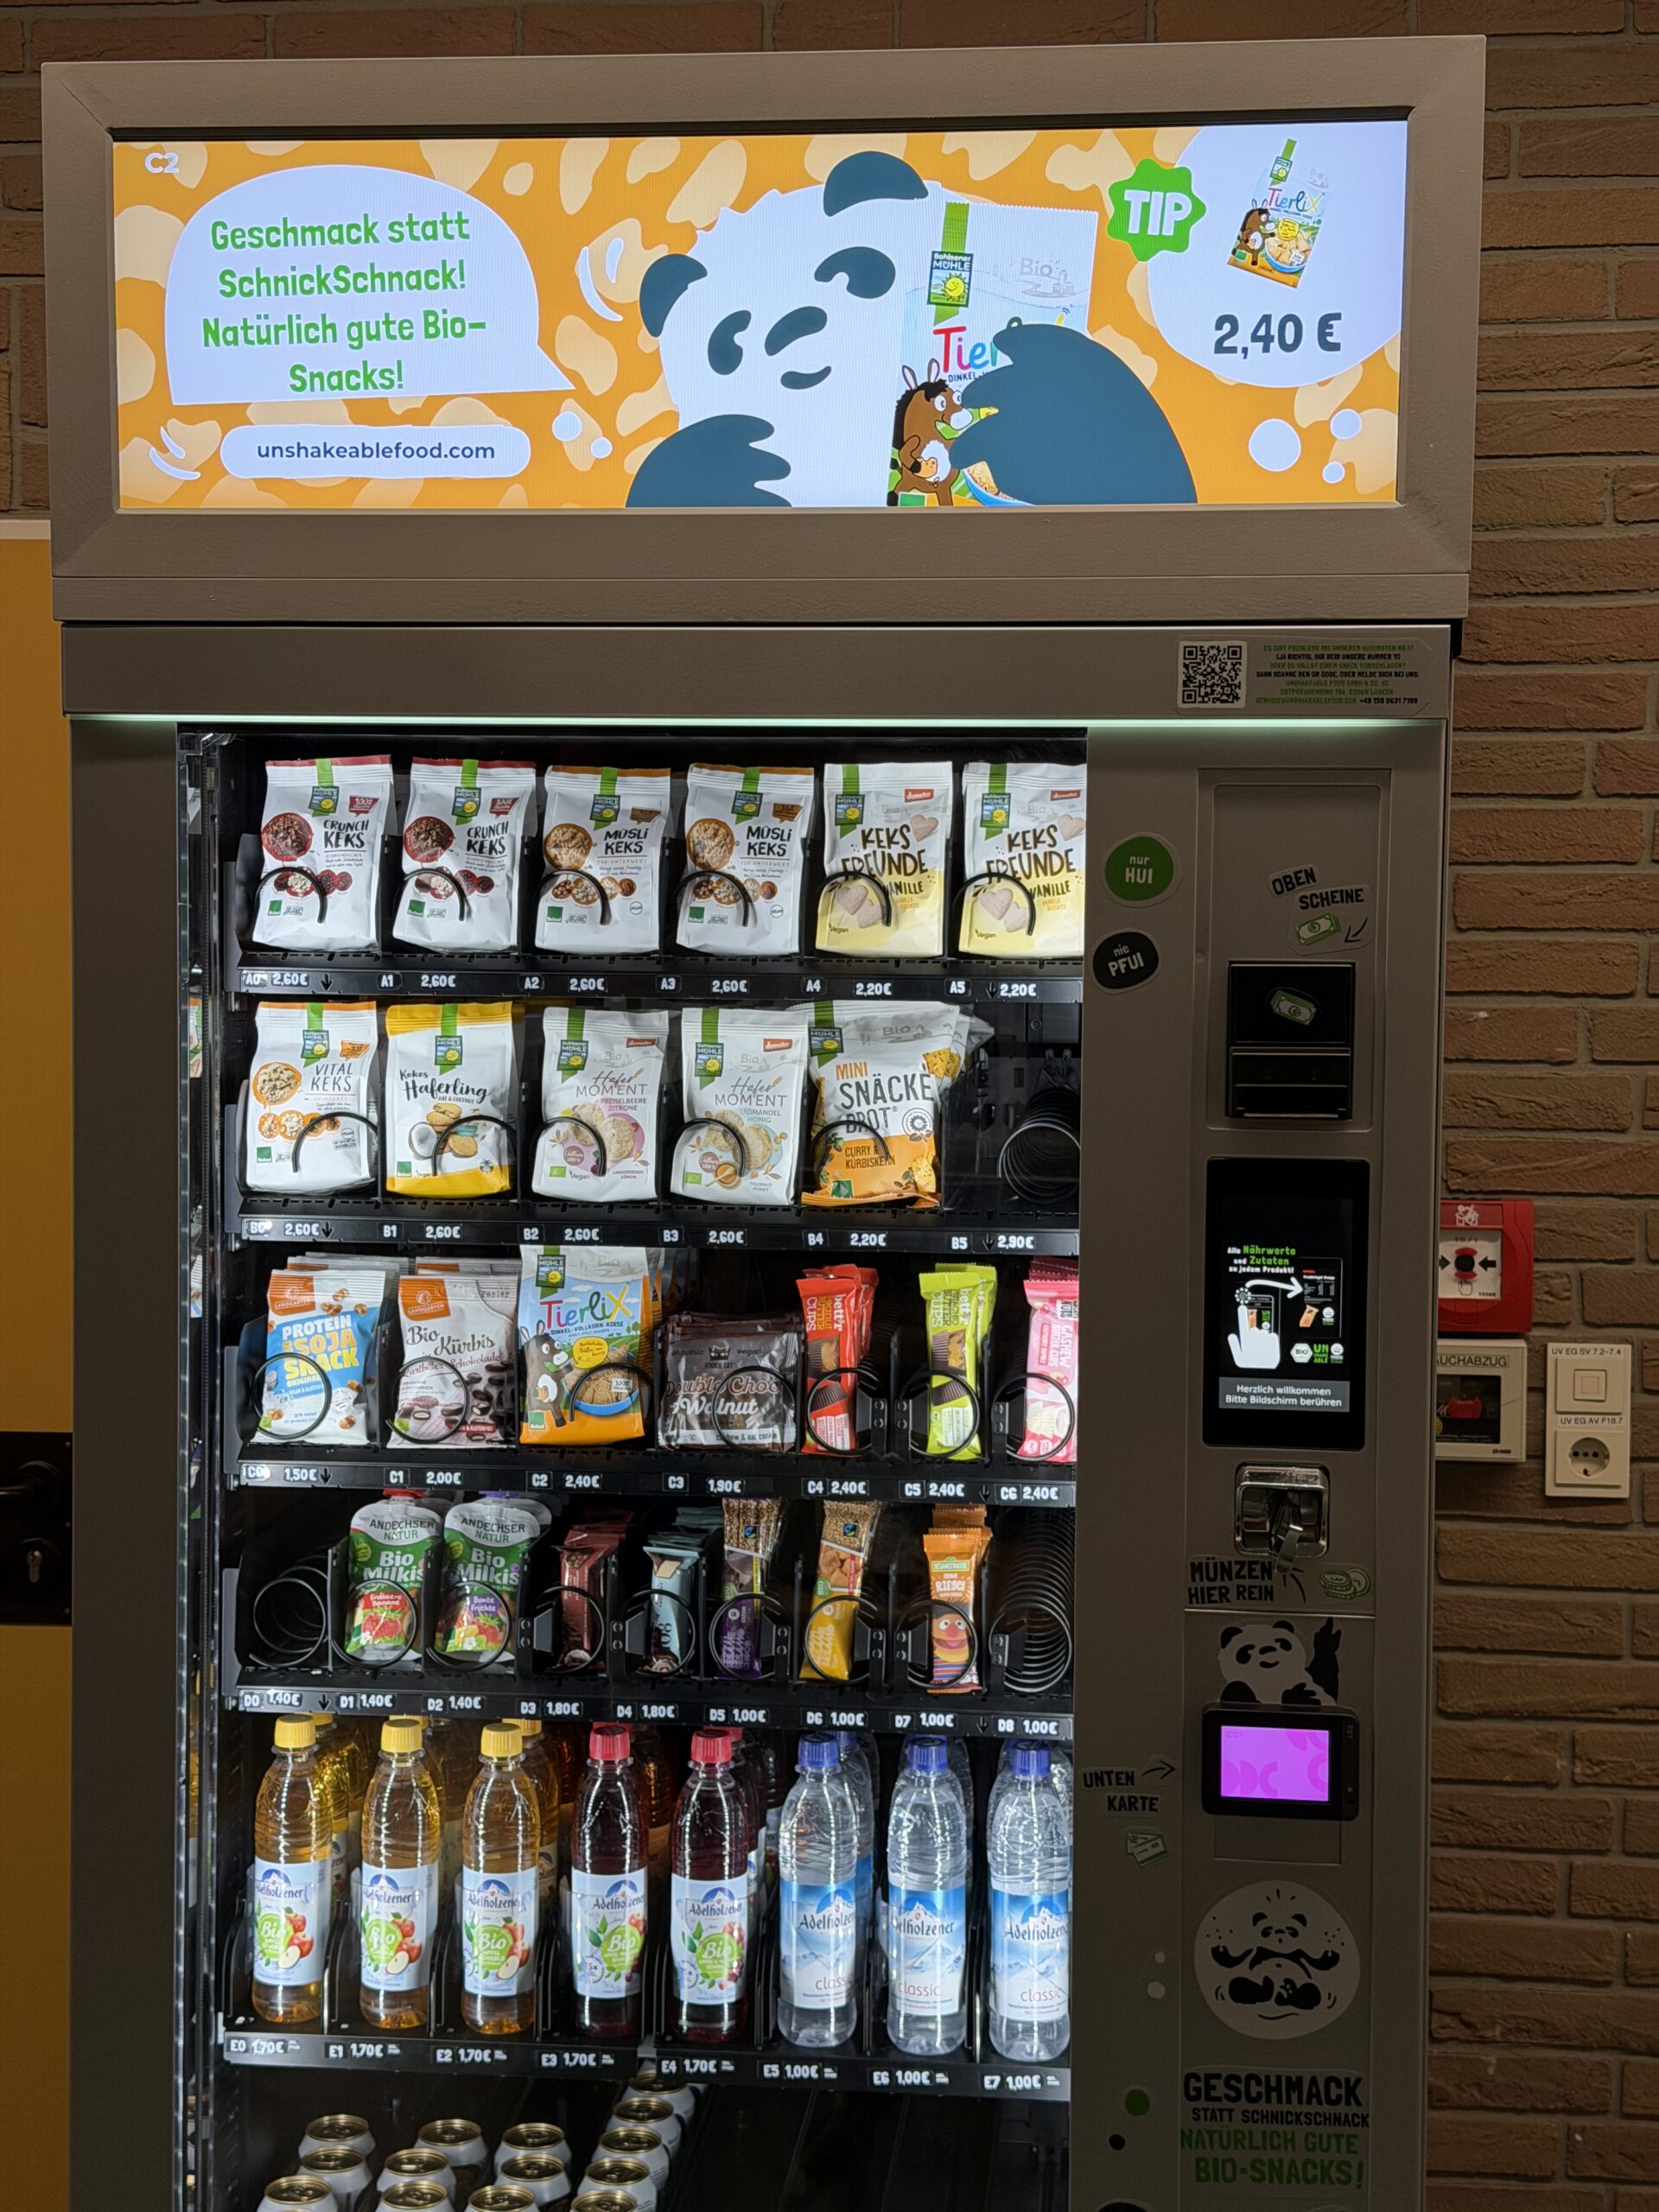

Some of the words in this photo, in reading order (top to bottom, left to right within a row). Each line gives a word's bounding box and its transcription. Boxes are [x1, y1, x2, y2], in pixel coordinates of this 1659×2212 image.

[145, 153, 179, 174] C2
[1123, 189, 1192, 236] TIP
[211, 213, 378, 251] Geschmack
[388, 211, 470, 245] statt
[932, 260, 971, 271] MÜHLE
[933, 253, 971, 262] Bohlsener
[219, 260, 466, 298] SchnickSchnack!
[202, 313, 338, 347] Natürlich
[346, 312, 414, 350] gute
[1214, 314, 1303, 359] 2,40
[1318, 313, 1342, 352] €
[289, 360, 404, 392] Snacks!
[257, 442, 495, 461] unshakeablefood.com
[323, 819, 369, 831] CRUNCH
[467, 822, 509, 838] CRUNCH
[323, 830, 365, 849] KEKS
[747, 825, 791, 842] MÜSLI
[861, 824, 911, 850] KEKS
[1007, 824, 1058, 852] KEKS
[466, 836, 506, 855] KEKS
[605, 842, 643, 855] KEKS
[747, 842, 786, 857] KEKS
[1129, 855, 1149, 865] nur
[1125, 868, 1153, 885] HUI
[1272, 868, 1317, 897] OBEN
[1300, 888, 1364, 910] SCHEINE
[1114, 944, 1129, 957] nie
[1108, 952, 1145, 977] PFUI
[272, 973, 308, 985] 2,60€
[380, 975, 394, 987] A1
[421, 975, 455, 987] 2,60€
[524, 976, 539, 988] A2
[569, 978, 605, 991] 2,60€
[806, 979, 821, 992] A4
[855, 983, 892, 995] 2,20€
[950, 982, 965, 994] A5
[1000, 983, 1036, 996] 2,20€
[315, 1062, 353, 1076] VITAL
[399, 1070, 429, 1082] Kokos
[836, 1061, 868, 1080] MINI
[311, 1076, 352, 1092] KEKS
[593, 1071, 633, 1085] Hafer
[731, 1077, 774, 1094] Hafer
[403, 1078, 489, 1104] Haferling
[575, 1084, 648, 1098] MOMENT
[839, 1073, 935, 1109] SNÄCKE
[715, 1094, 787, 1108] MOMENT
[845, 1146, 871, 1157] CURRY
[383, 1225, 397, 1237] B1
[425, 1225, 460, 1238] 2,60€
[524, 1229, 539, 1240] B2
[564, 1229, 600, 1241] 2,60€
[808, 1234, 823, 1245] B4
[850, 1233, 887, 1246] 2,20€
[952, 1236, 967, 1249] B5
[997, 1236, 1034, 1249] 2,90€
[1243, 1244, 1296, 1255] Nährwerte
[1249, 1255, 1289, 1265] Zutaten
[1239, 1265, 1260, 1274] jedem
[806, 1296, 816, 1331] CUPS
[931, 1291, 942, 1327] CUPS
[282, 1315, 351, 1339] PROTEIN
[407, 1325, 440, 1344] Bio
[296, 1332, 356, 1352] SOJA
[434, 1335, 495, 1357] Kürbis
[1060, 1325, 1073, 1369] CASHEW
[728, 1375, 779, 1395] Choc
[1236, 1384, 1274, 1394] Herzlich
[1276, 1386, 1331, 1395] willkommen
[1225, 1395, 1248, 1403] Bitte
[1249, 1395, 1297, 1405] Bildschirm
[1300, 1396, 1342, 1407] berühren
[390, 1471, 404, 1483] C1
[425, 1471, 461, 1484] 2,00€
[532, 1474, 548, 1486] C2
[565, 1474, 600, 1487] 2,40€
[807, 1481, 823, 1493] C4
[831, 1481, 865, 1495] 2,40€
[1001, 1486, 1016, 1500] C6
[1023, 1486, 1058, 1500] 2,40€
[370, 1518, 434, 1529] ANDECHSER
[461, 1517, 525, 1533] ANDECHSER
[384, 1529, 418, 1540] NATUR
[475, 1532, 510, 1543] NATUR
[380, 1550, 414, 1567] Bio
[472, 1548, 505, 1567] Bio
[457, 1564, 520, 1585] Milkis
[1191, 1557, 1272, 1581] MÜNZEN
[474, 1596, 494, 1605] Bunte
[1188, 1586, 1230, 1604] HIER
[1236, 1585, 1274, 1600] REIN
[520, 1702, 536, 1714] D3
[546, 1702, 579, 1714] 1,80€
[617, 1706, 632, 1718] D4
[641, 1705, 675, 1718] 1,80€
[806, 1713, 823, 1725] D6
[830, 1713, 864, 1726] 1,00€
[999, 1719, 1014, 1732] D8
[1023, 1719, 1058, 1733] 1,00€
[1084, 1771, 1135, 1789] UNTEN
[1108, 1796, 1158, 1812] KARTE
[479, 1932, 507, 1951] Bio
[608, 1933, 638, 1952] Bio
[329, 2044, 342, 2057] E1
[350, 2044, 384, 2057] 1,70€
[541, 2053, 556, 2066] E3
[563, 2053, 596, 2067] 1,70€
[662, 2061, 677, 2074] E4
[683, 2060, 717, 2074] 1,70€
[764, 2065, 779, 2078] E5
[785, 2065, 817, 2079] 1,00€
[983, 2075, 1001, 2089] E7
[1006, 2075, 1040, 2089] 1,00€
[1184, 2072, 1362, 2107] GESCHMACK
[1192, 2107, 1234, 2122] STATT
[1181, 2125, 1296, 2152] NATÜRLICH
[1305, 2132, 1358, 2154] GUTE
[1195, 2157, 1363, 2189] BIO-SNACKS!
